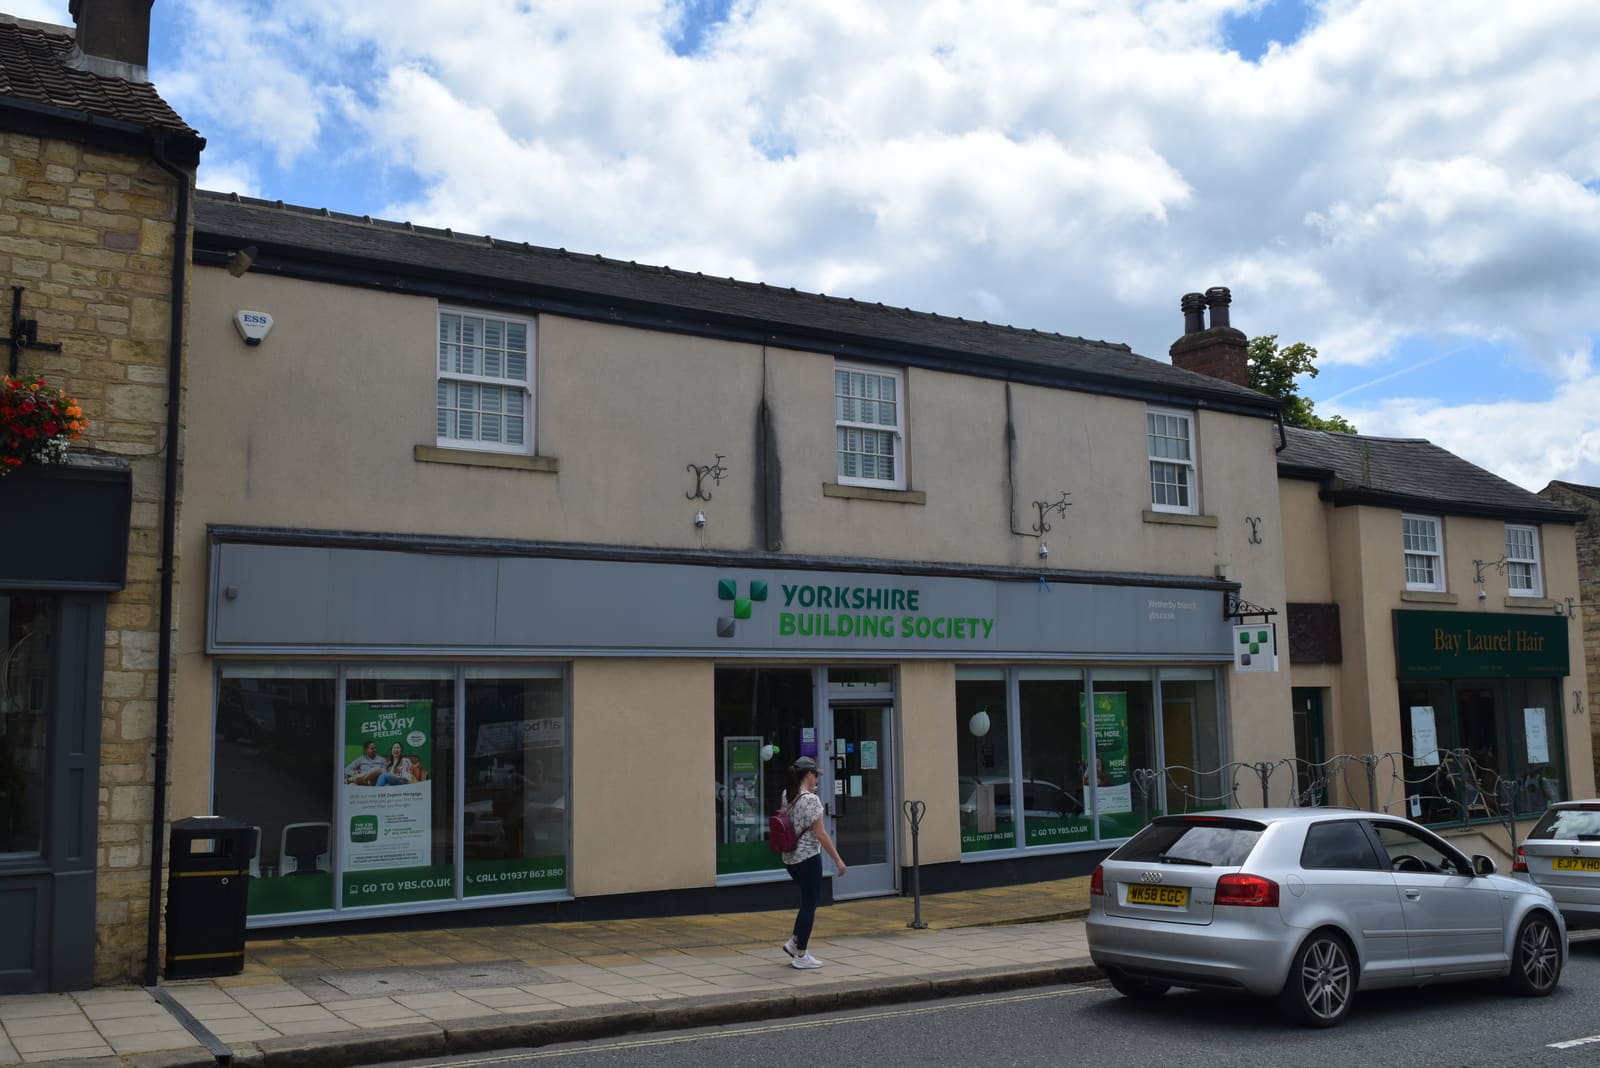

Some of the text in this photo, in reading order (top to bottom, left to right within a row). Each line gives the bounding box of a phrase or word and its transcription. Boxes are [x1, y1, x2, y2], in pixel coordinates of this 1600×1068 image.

[243, 314, 267, 324] ESS
[781, 584, 919, 611] YORKSHIRE
[779, 613, 994, 639] BUILDING SOCIETY
[1434, 628, 1544, 657] Bay Laurel Hair
[378, 712, 398, 721] THAT
[361, 716, 415, 733] £5K YAY
[373, 729, 402, 738] FEELING
[1038, 825, 1088, 837] GO TO YBS.CO.UK
[962, 835, 976, 843] CALL
[476, 868, 564, 882] CALL 01937 862 880
[362, 878, 451, 893] GO TO YBS.CO.UK
[1160, 889, 1182, 902] EGC
